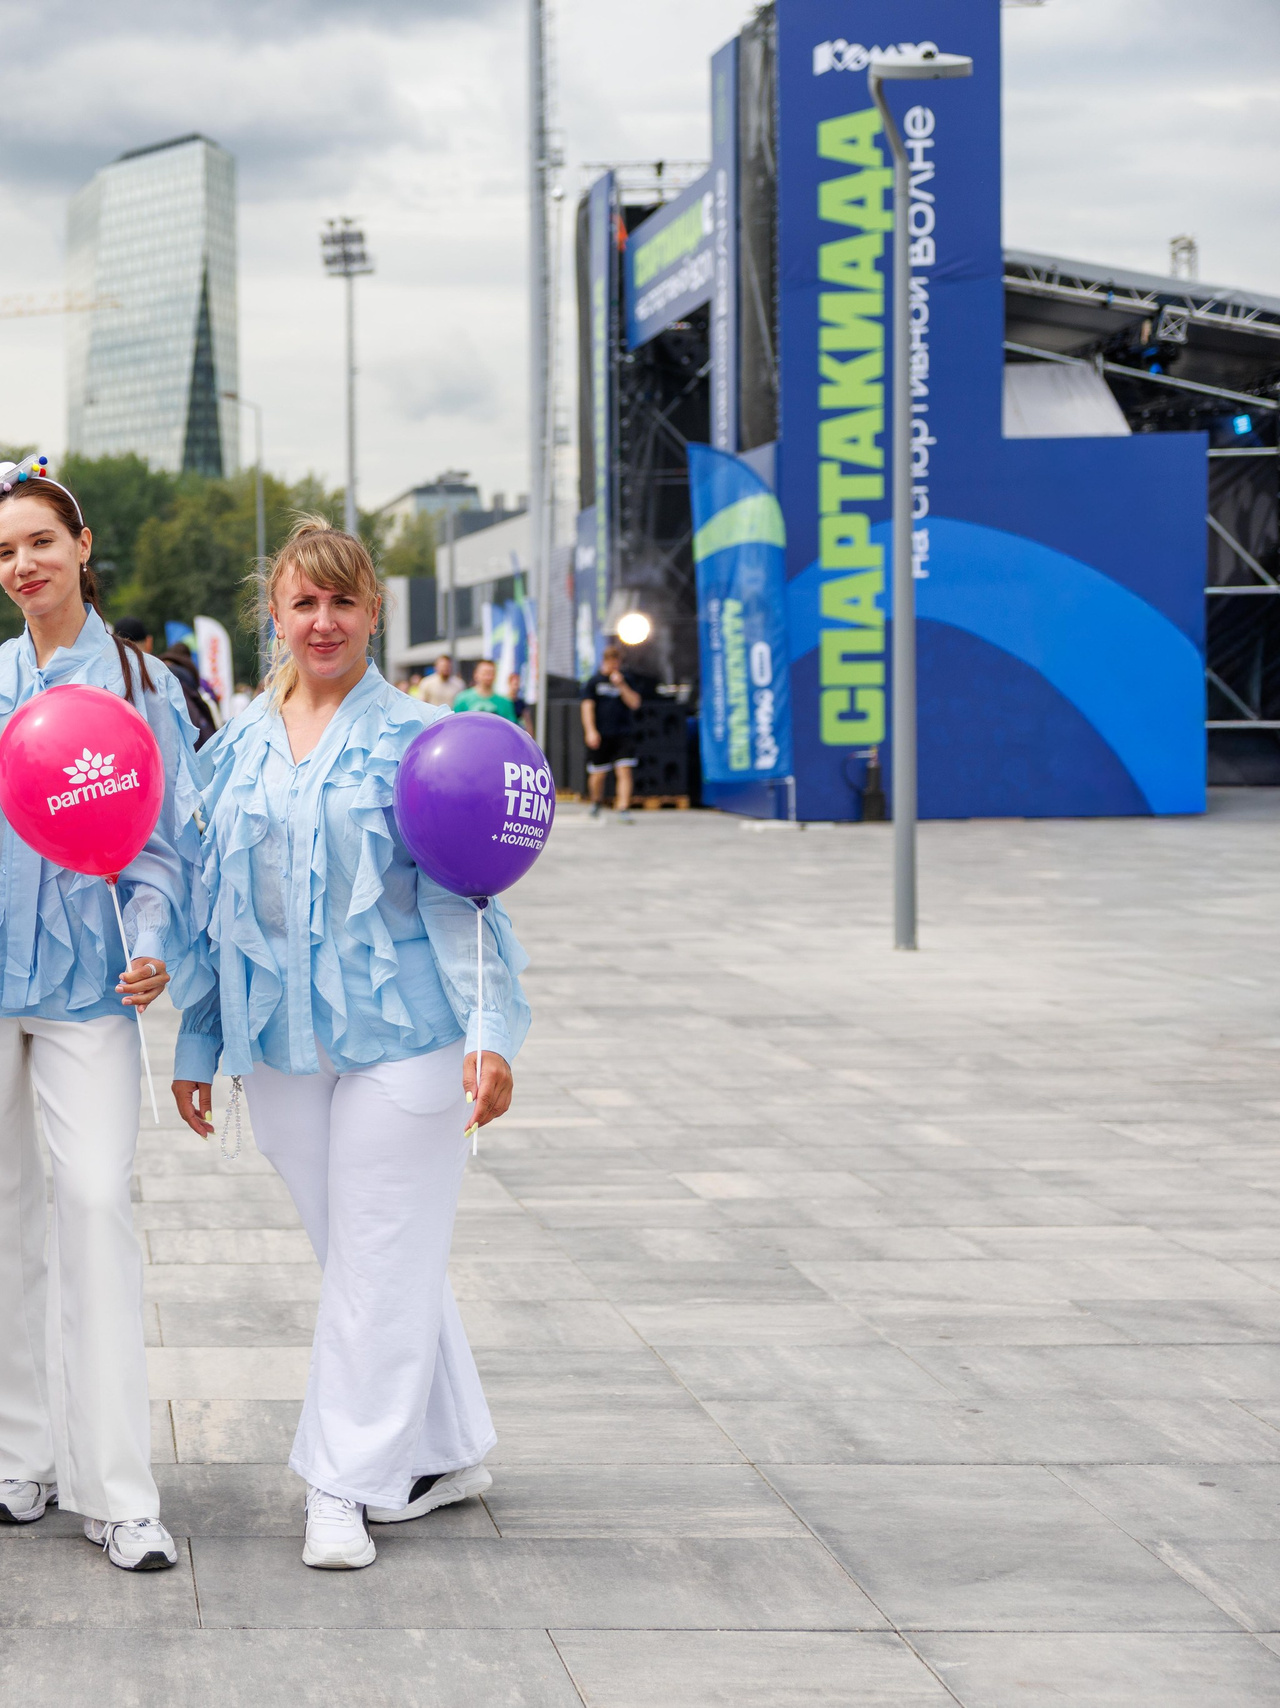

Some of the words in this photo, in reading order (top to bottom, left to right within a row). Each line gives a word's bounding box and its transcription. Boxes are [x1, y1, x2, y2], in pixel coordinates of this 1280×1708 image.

[817, 106, 894, 746] СПАРТАКИАДА
[47, 768, 140, 815] parmalat
[503, 761, 550, 795] PRO
[504, 789, 551, 824] TEIN
[503, 821, 544, 838] МОЛОКО
